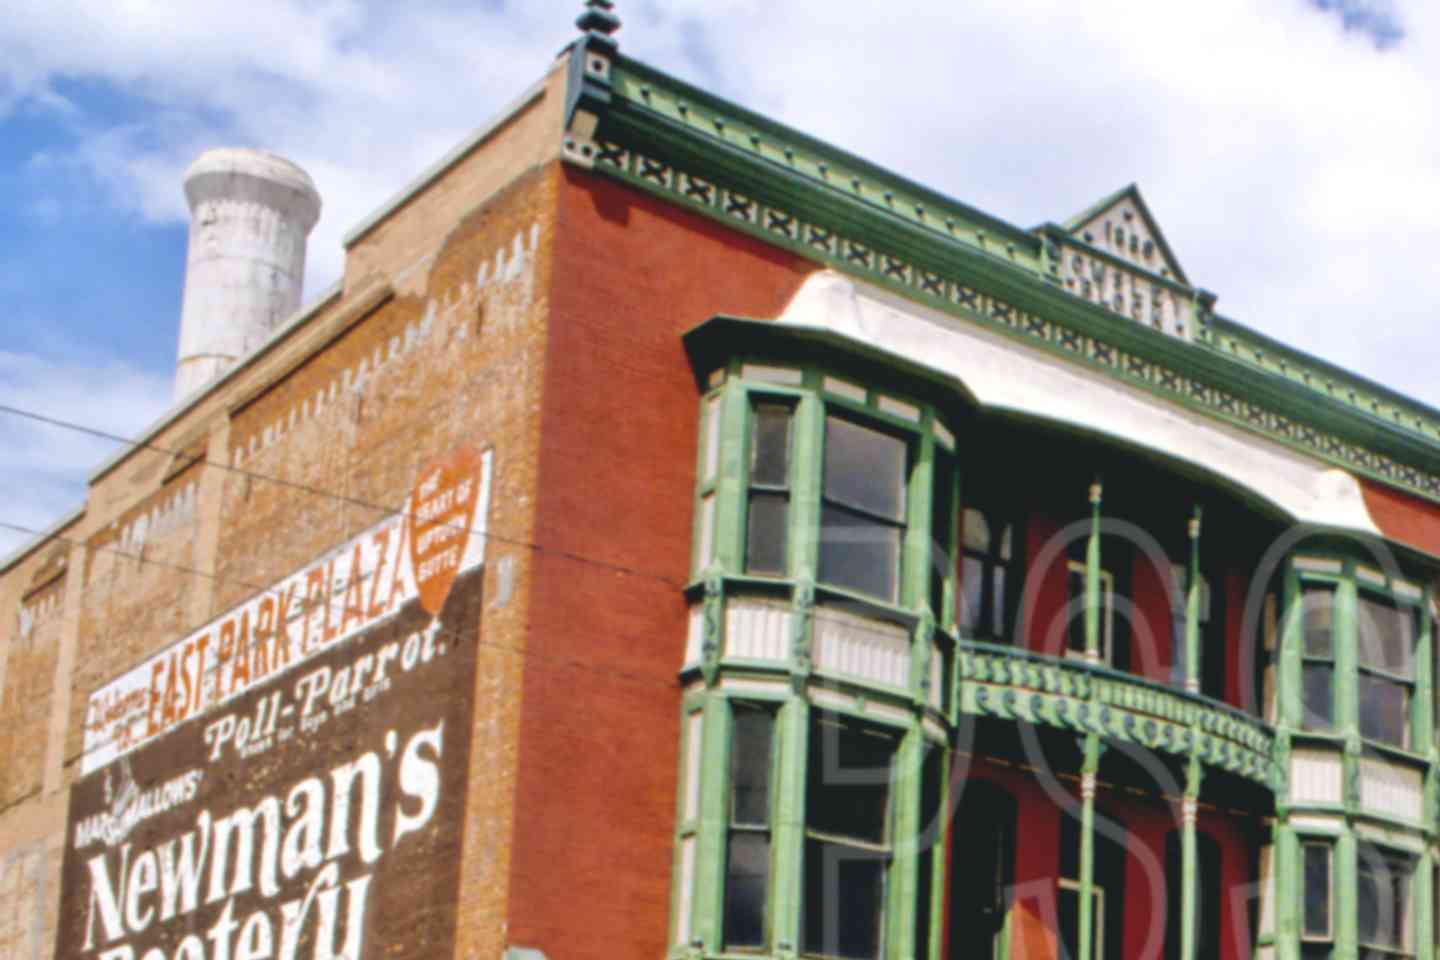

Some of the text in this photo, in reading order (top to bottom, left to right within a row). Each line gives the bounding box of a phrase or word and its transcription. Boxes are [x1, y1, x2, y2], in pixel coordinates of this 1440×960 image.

[146, 520, 411, 739] EAST PARK PLAZA
[80, 717, 447, 953] Newman's
